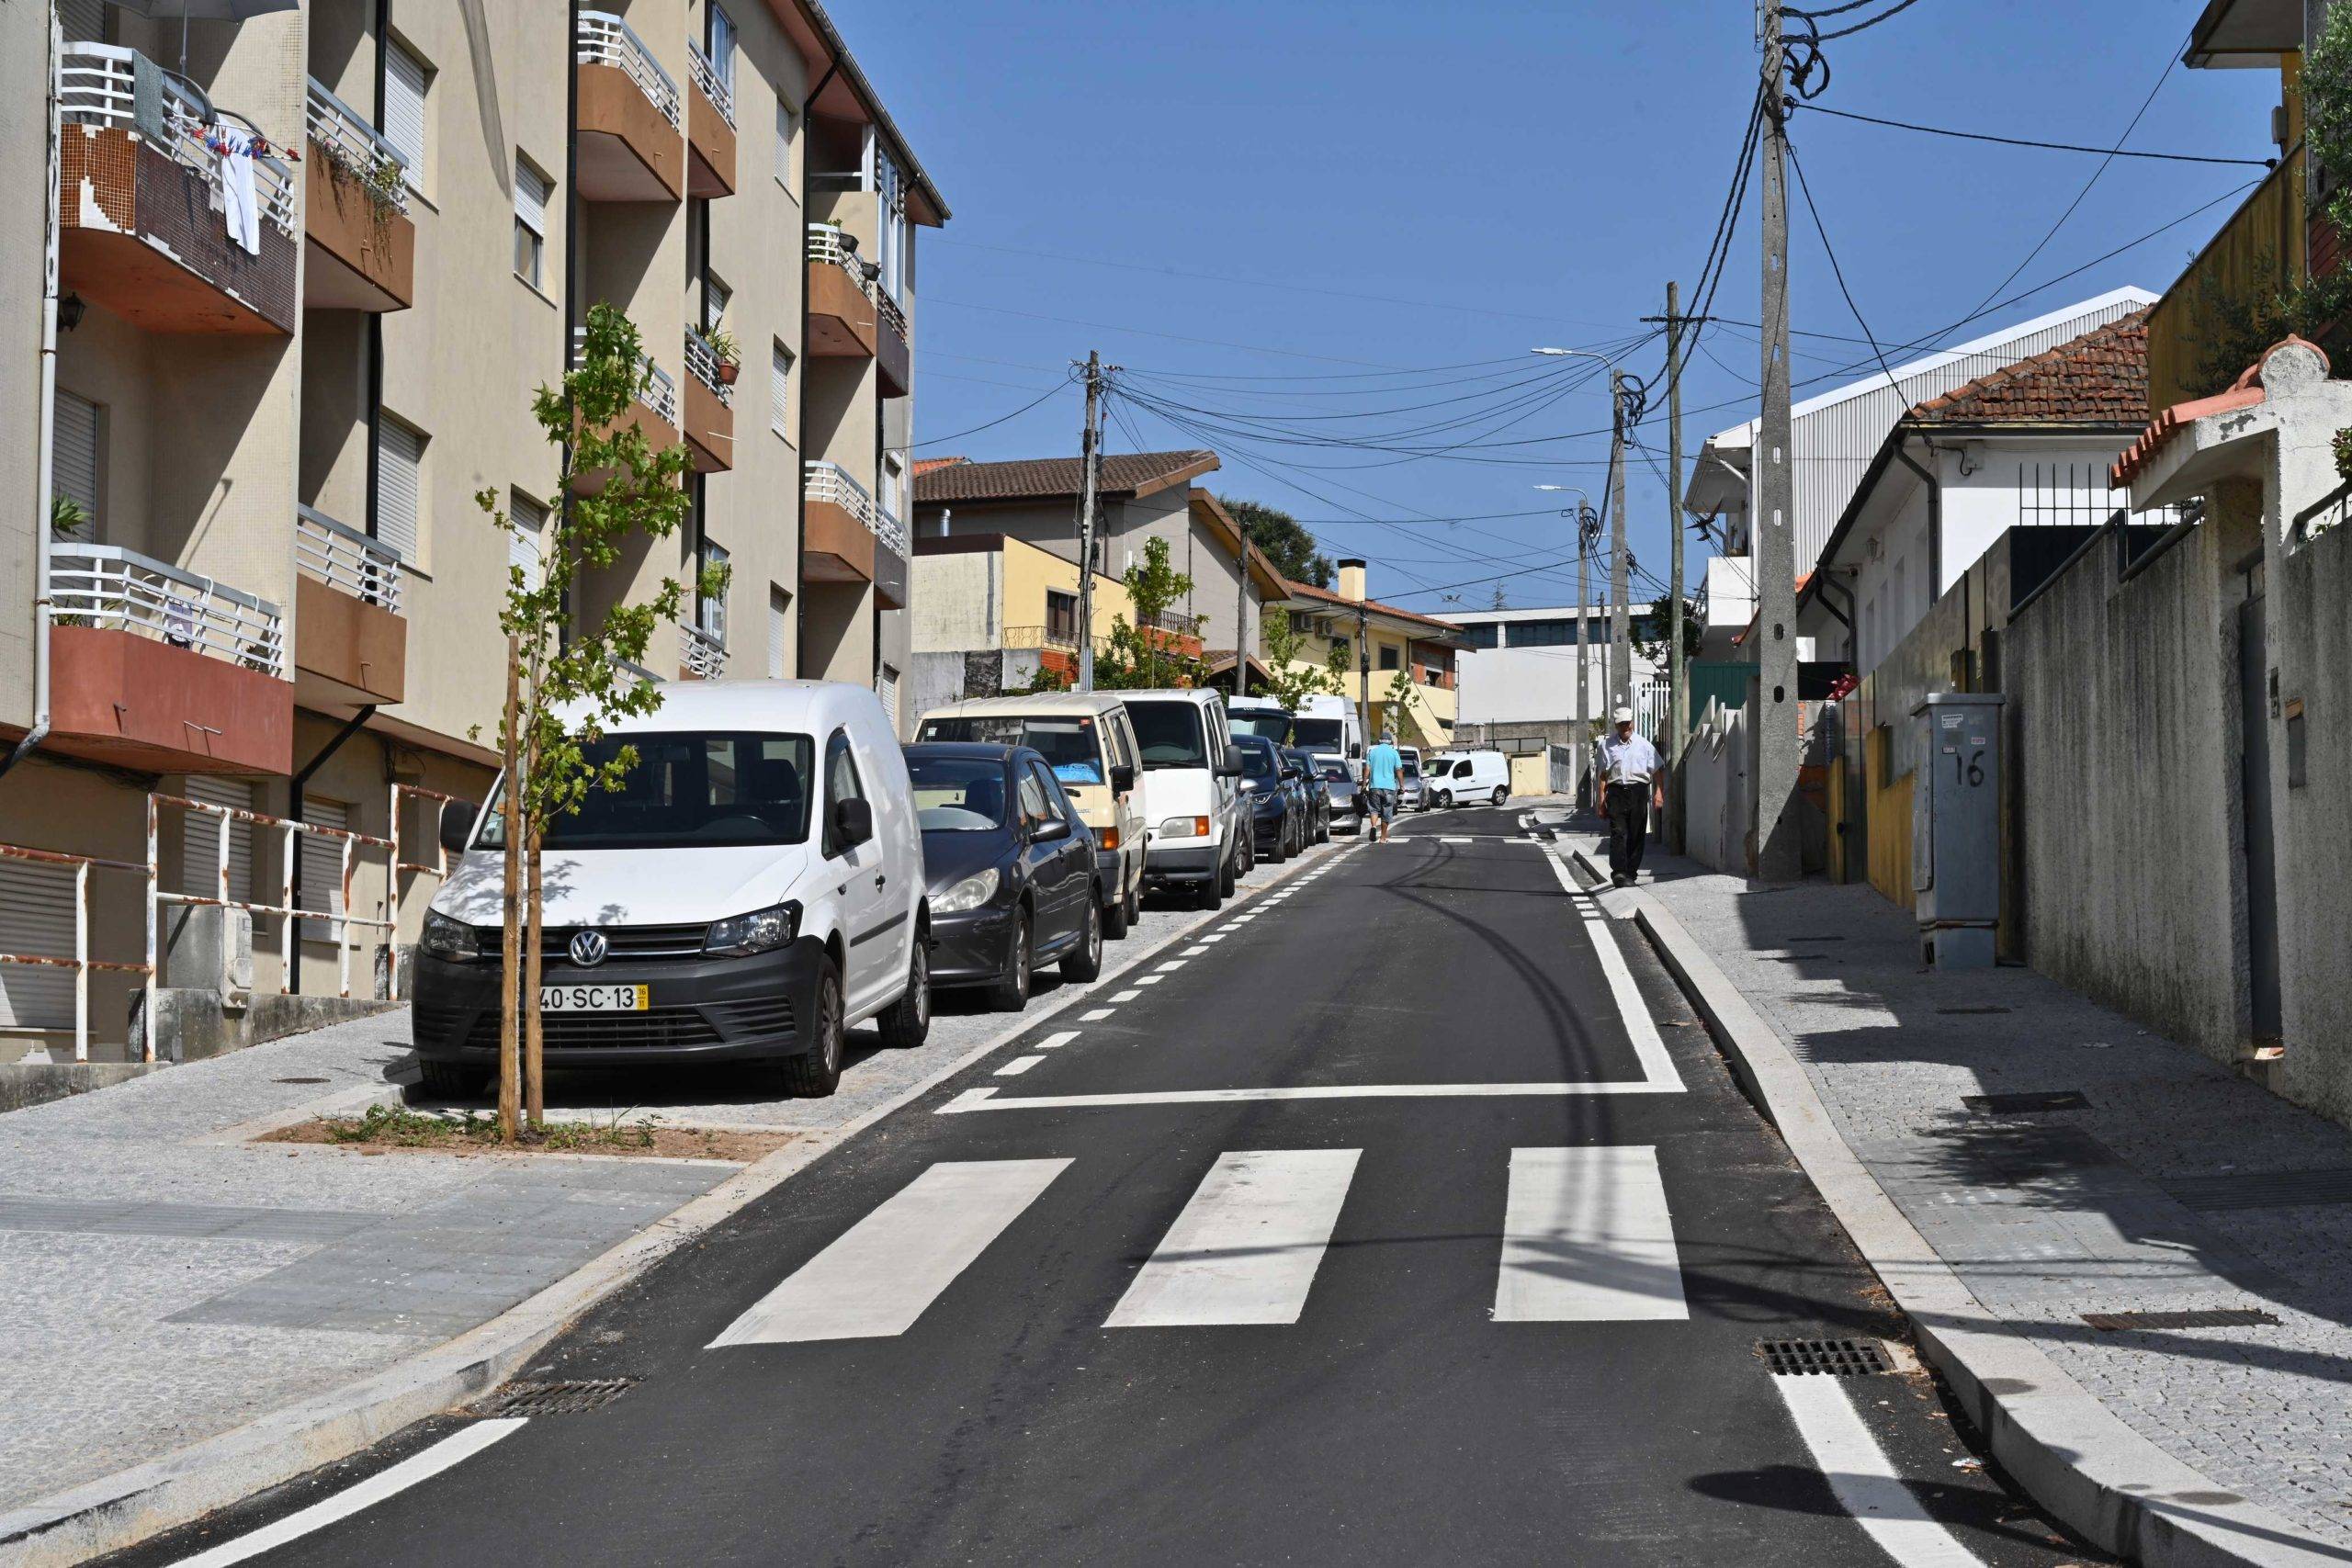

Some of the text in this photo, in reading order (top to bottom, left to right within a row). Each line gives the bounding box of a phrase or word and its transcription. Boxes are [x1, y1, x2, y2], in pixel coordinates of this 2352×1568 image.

[1957, 750, 1984, 787] 16
[571, 931, 605, 964] VW
[639, 987, 647, 996] 16
